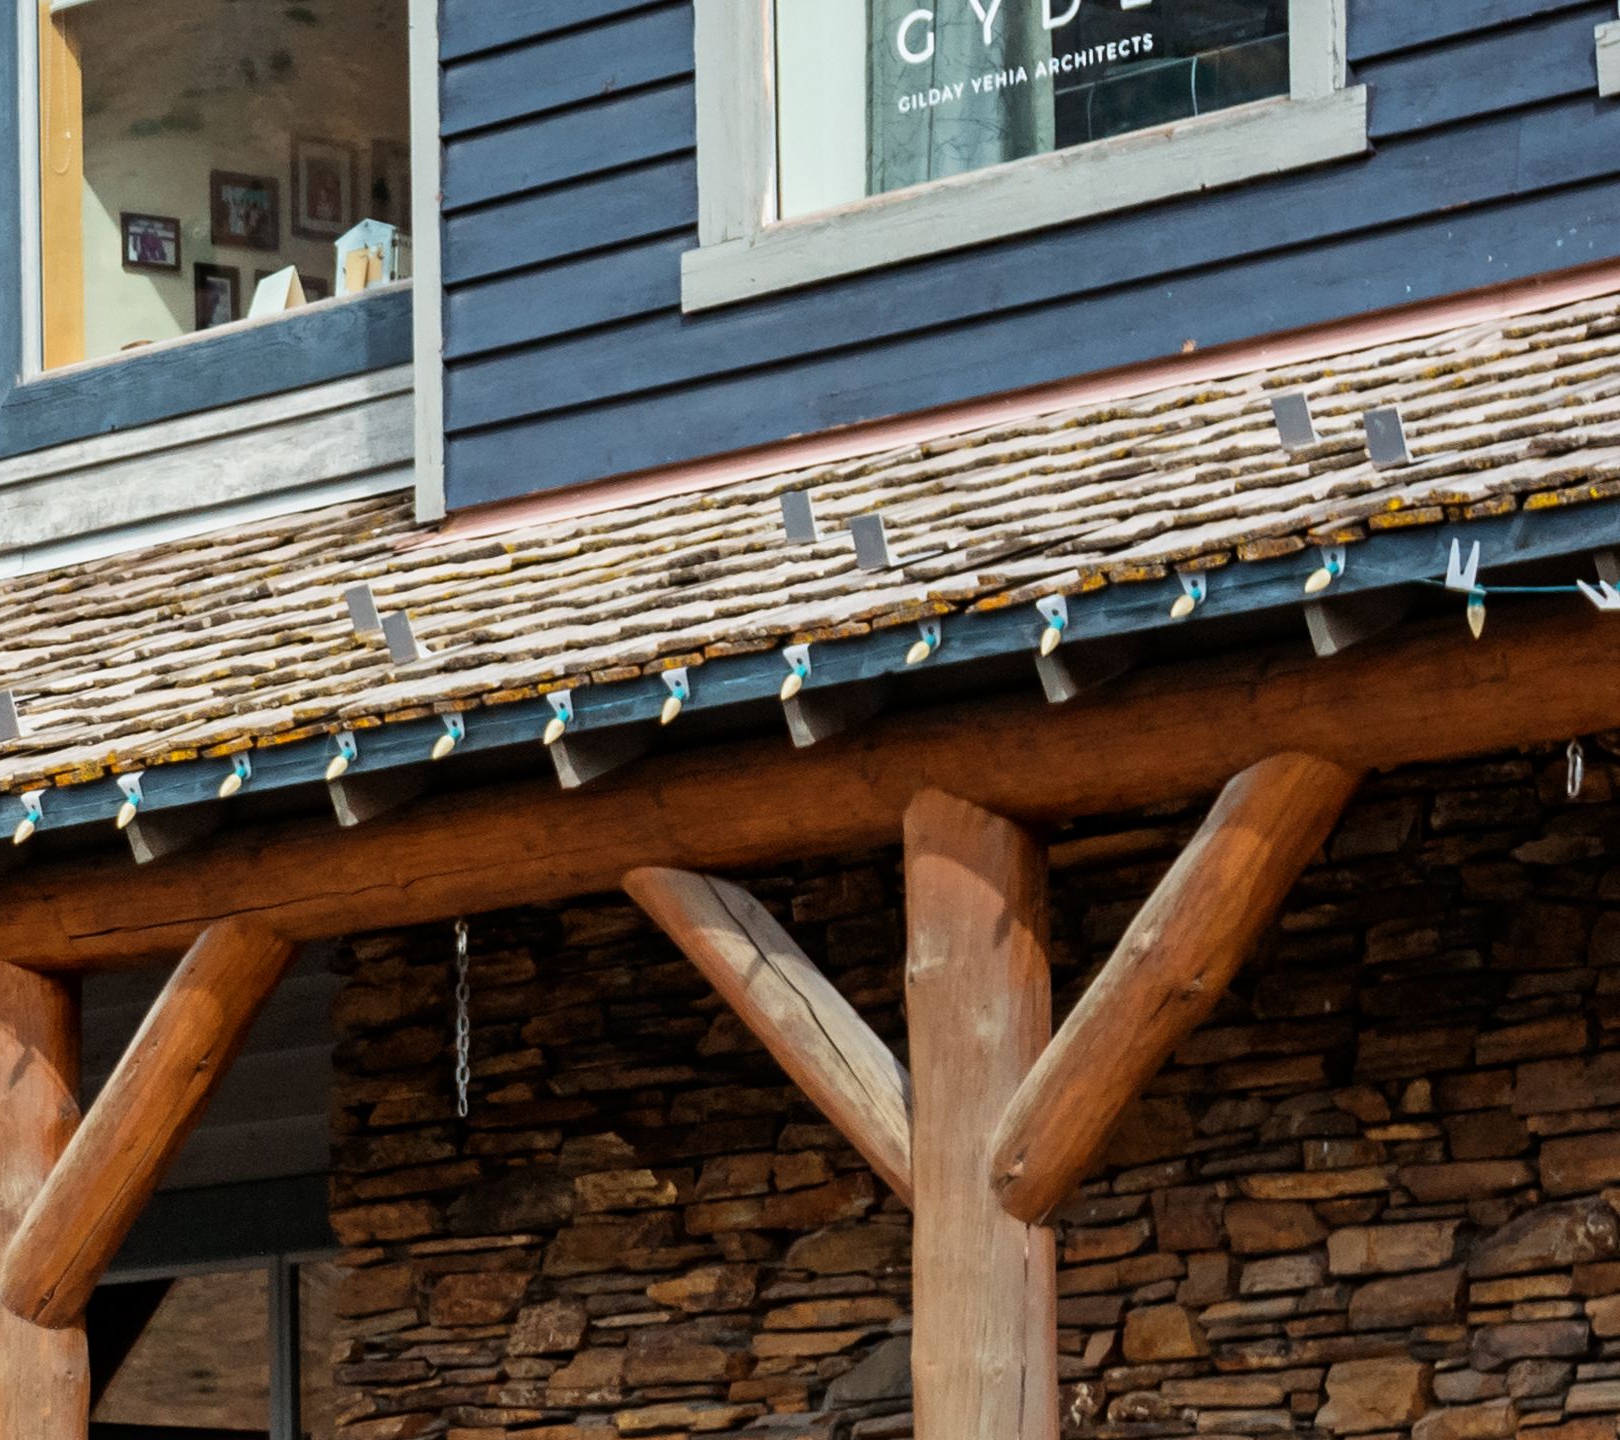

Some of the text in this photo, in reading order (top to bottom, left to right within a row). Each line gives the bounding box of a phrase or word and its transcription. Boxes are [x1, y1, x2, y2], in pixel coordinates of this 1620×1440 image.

[897, 32, 1155, 114] GILDAY YEHIA ARCHITECTS
